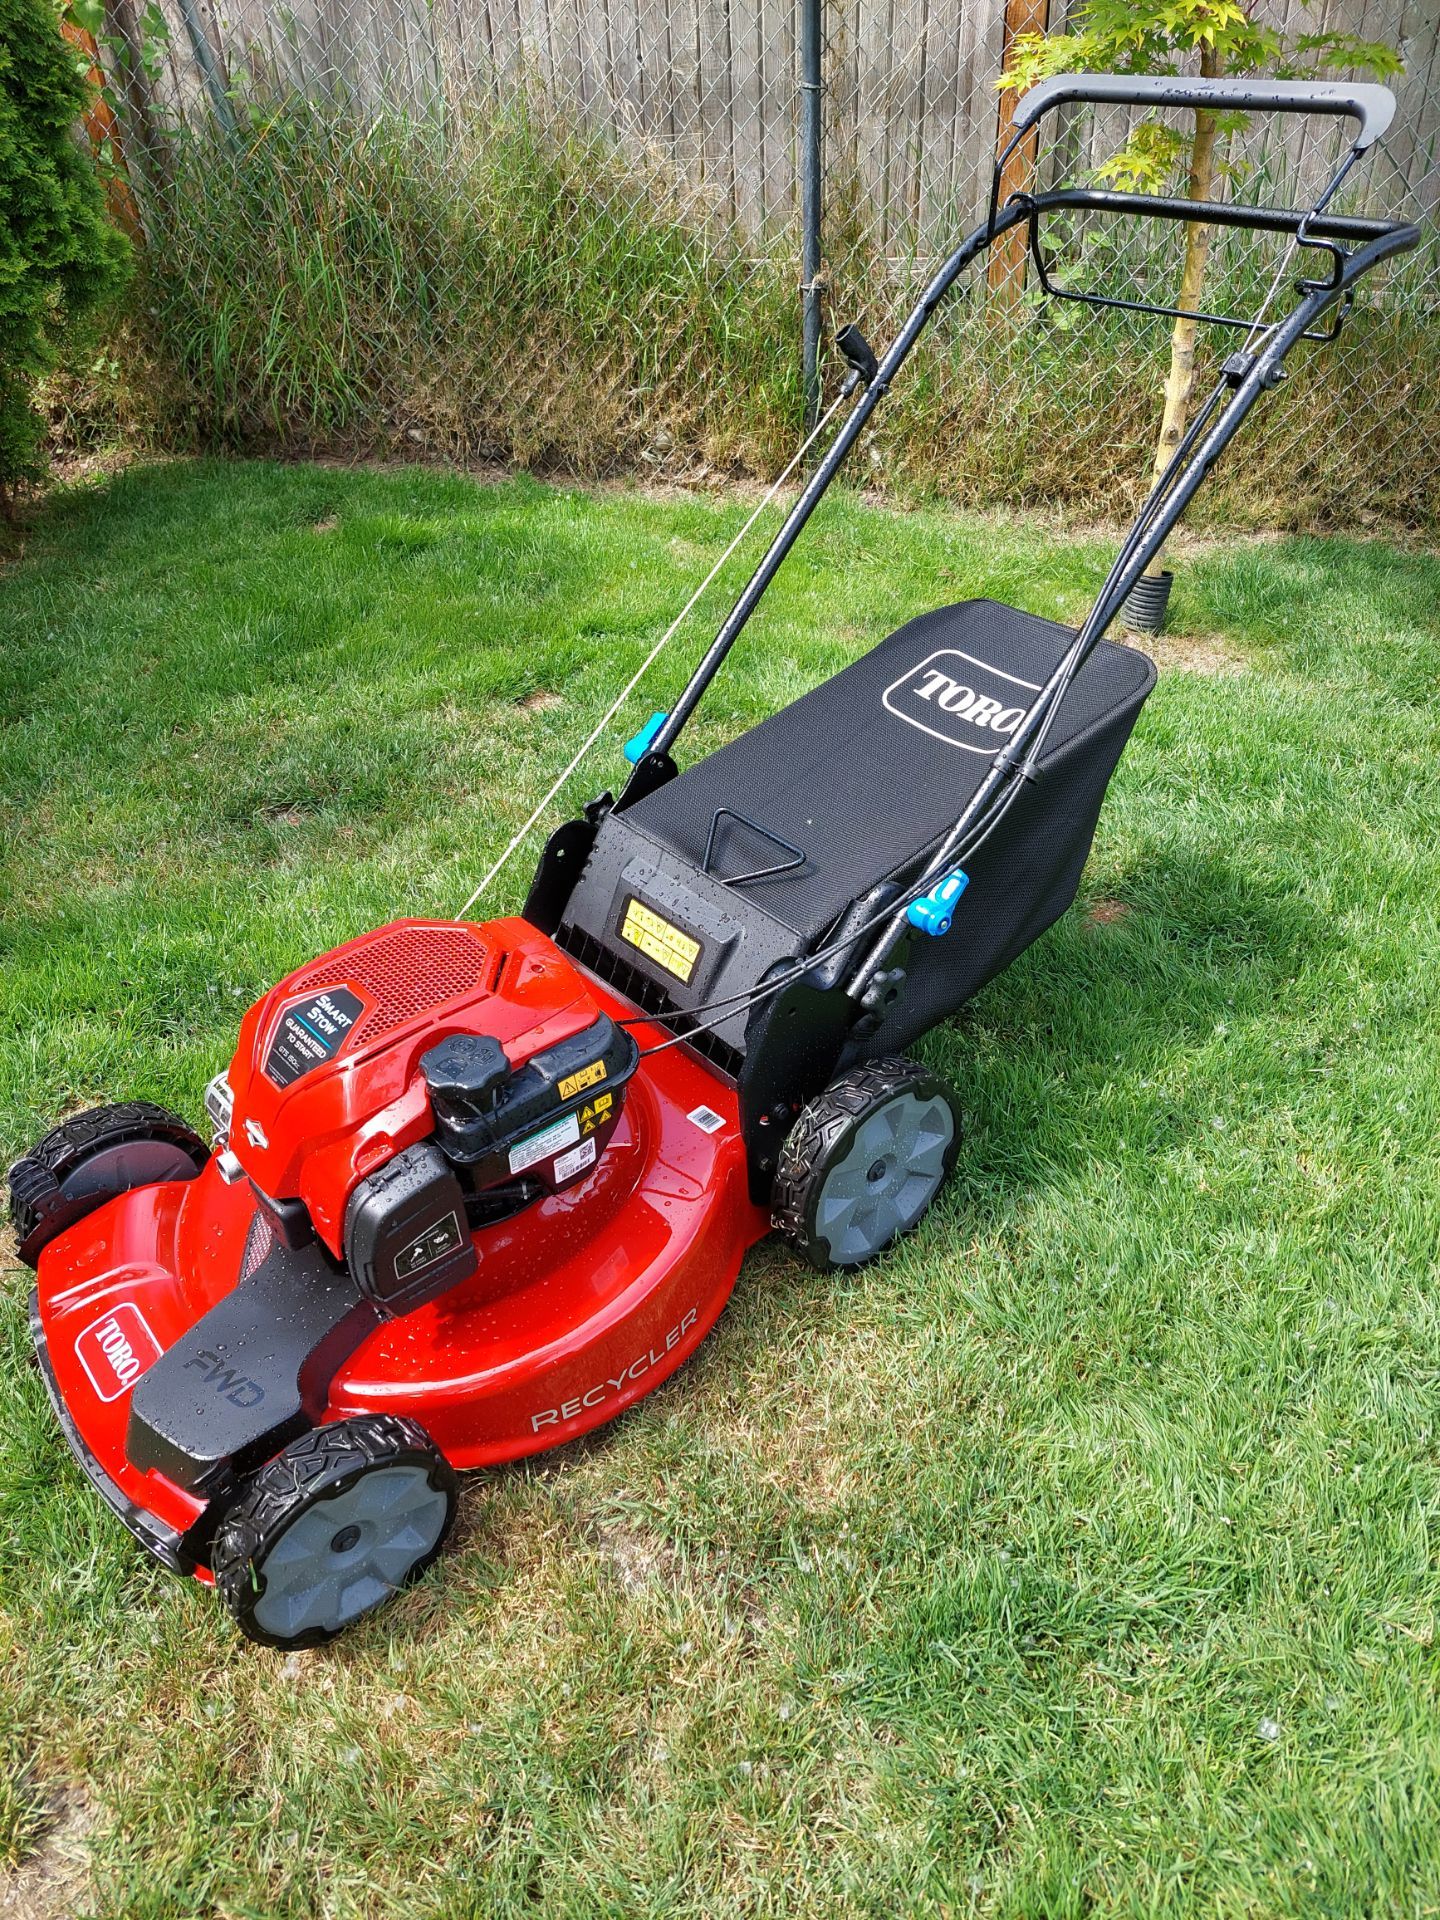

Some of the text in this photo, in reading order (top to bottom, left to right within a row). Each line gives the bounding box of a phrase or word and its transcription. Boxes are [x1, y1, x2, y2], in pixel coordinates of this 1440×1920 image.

[913, 669, 1027, 733] TORO
[307, 1006, 337, 1035] STOW
[315, 995, 353, 1028] SMART
[285, 1018, 327, 1059] GUARANTEED
[286, 1032, 315, 1060] TO START
[95, 1317, 140, 1382] TORO
[531, 1307, 697, 1433] RECYCLER
[182, 1350, 265, 1408] FWD
